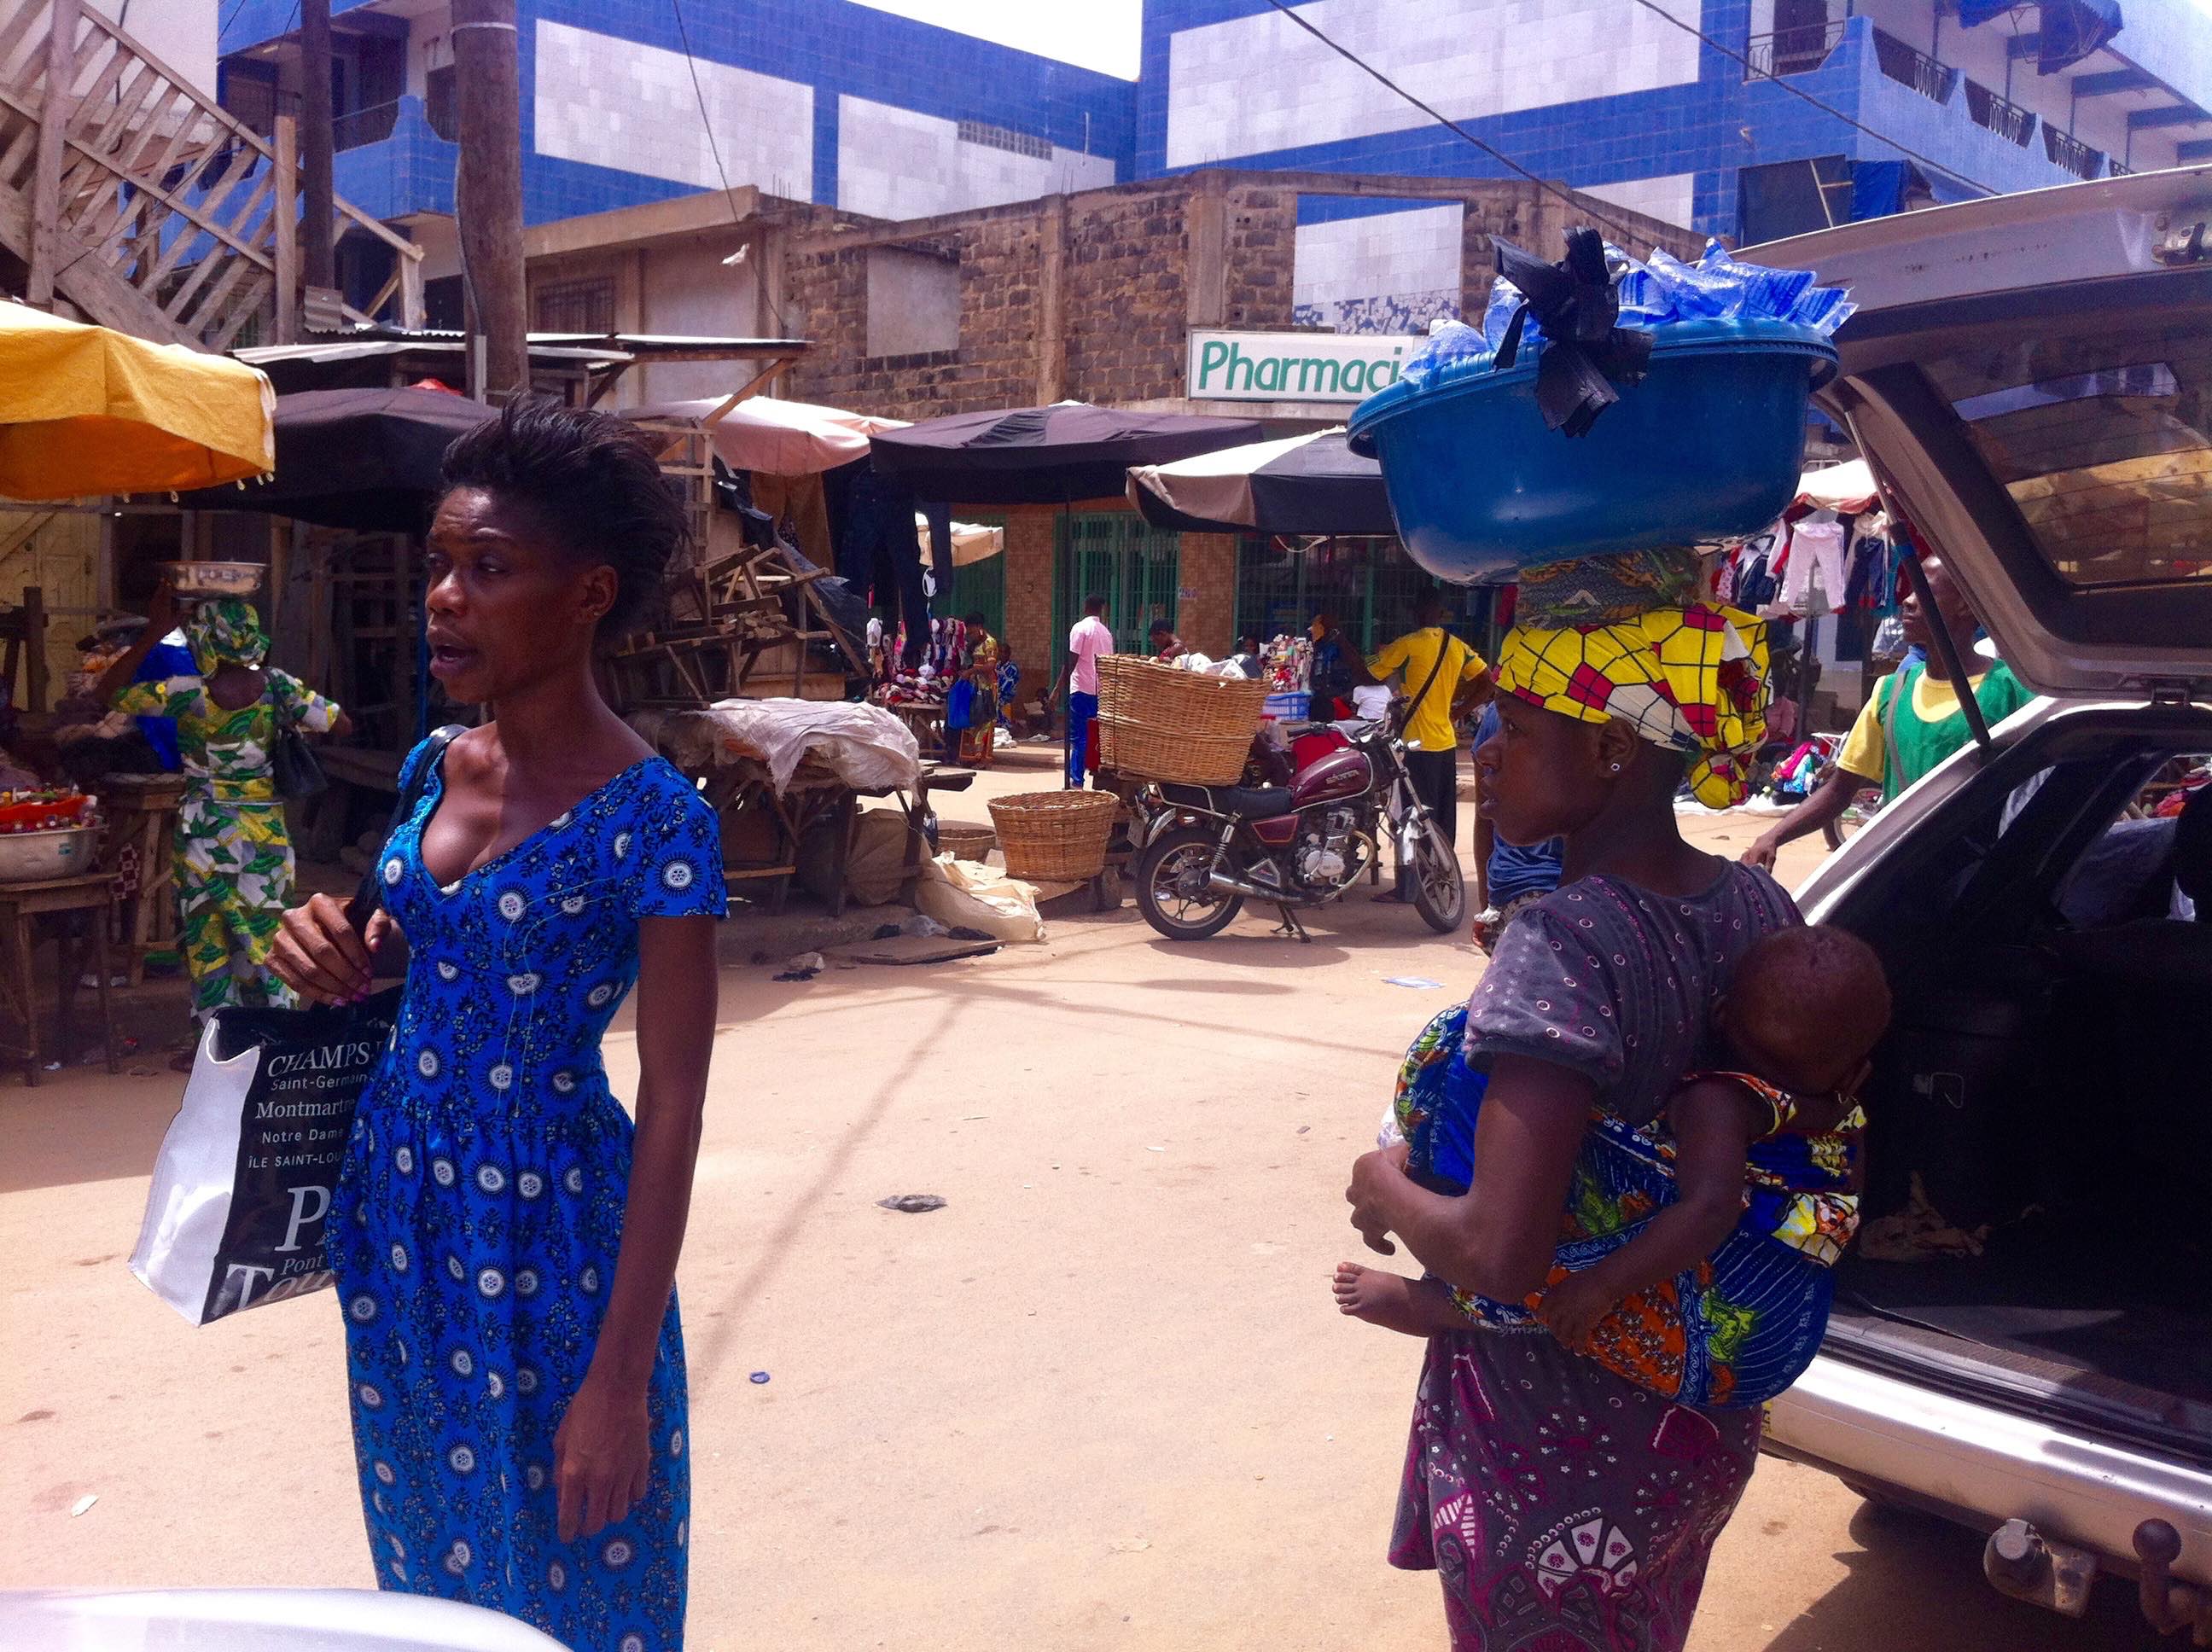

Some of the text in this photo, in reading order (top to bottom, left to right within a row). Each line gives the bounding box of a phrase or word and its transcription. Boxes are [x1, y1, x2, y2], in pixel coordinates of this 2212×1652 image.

[1197, 340, 1403, 393] Pharmaci
[267, 1041, 370, 1077] CHAMPS
[261, 1131, 302, 1144] Notre
[247, 1152, 341, 1169] ÎLE SAINT-LOU
[274, 1185, 331, 1252] P
[280, 1254, 325, 1276] Pont
